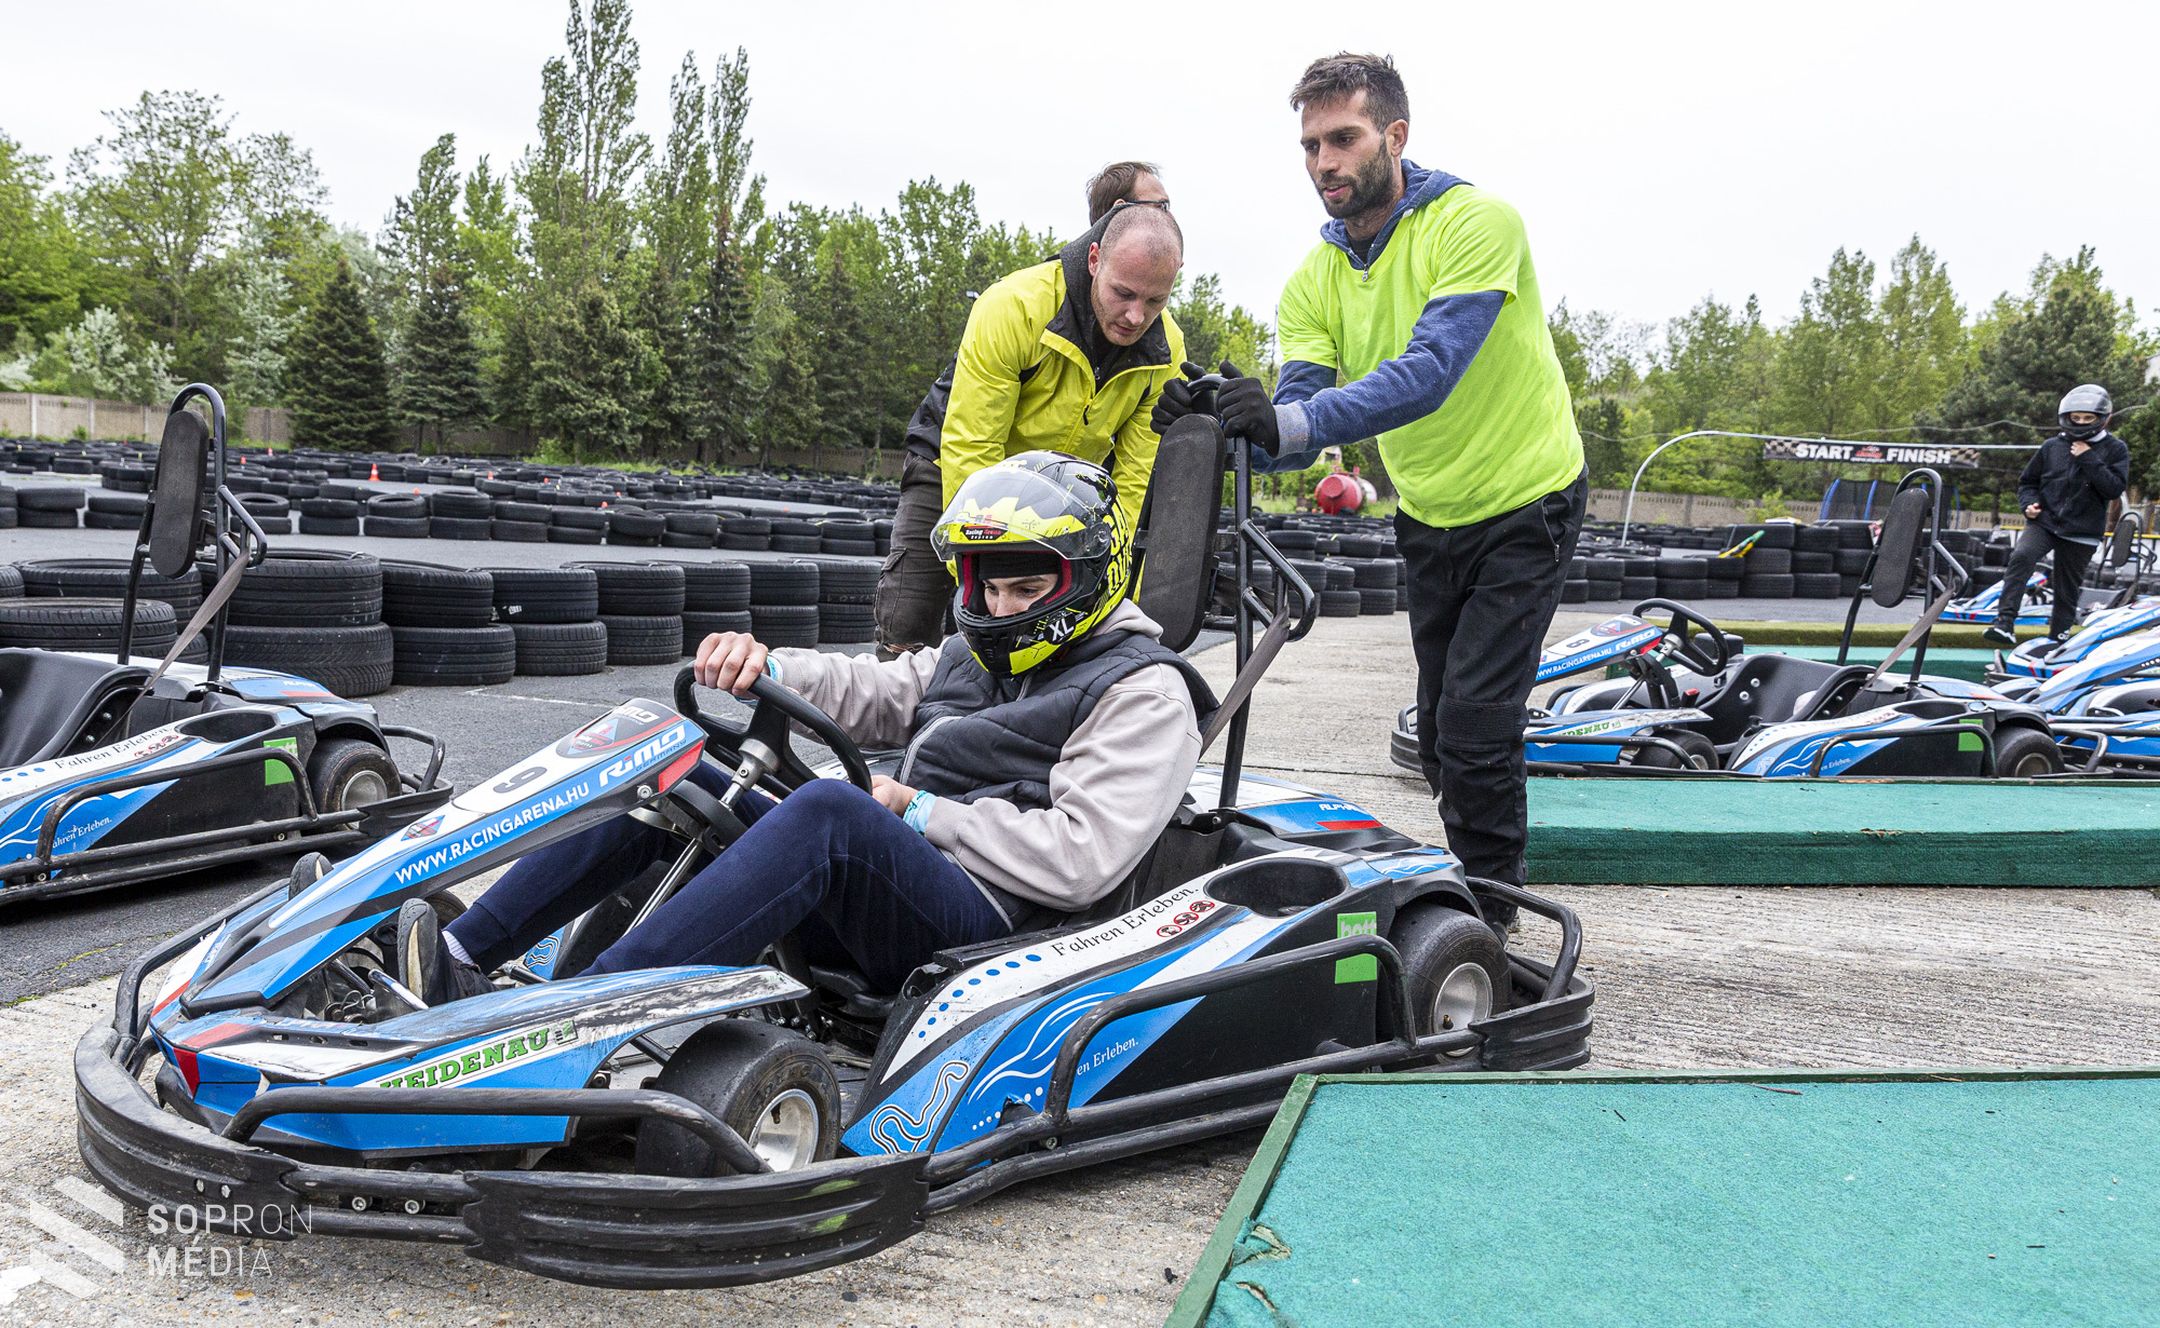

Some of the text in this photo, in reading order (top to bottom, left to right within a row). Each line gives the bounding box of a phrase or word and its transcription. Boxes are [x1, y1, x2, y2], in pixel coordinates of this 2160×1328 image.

[1796, 443, 1853, 461] START
[1886, 448, 1951, 465] FINISH
[1049, 618, 1075, 642] XL
[55, 749, 111, 769] Fahren
[52, 816, 112, 850] ahren Erleben.
[394, 781, 591, 885] WWW.RACINGARENA.HU
[1050, 886, 1199, 957] Fahren Erleben.
[1093, 1036, 1139, 1068] Erleben.
